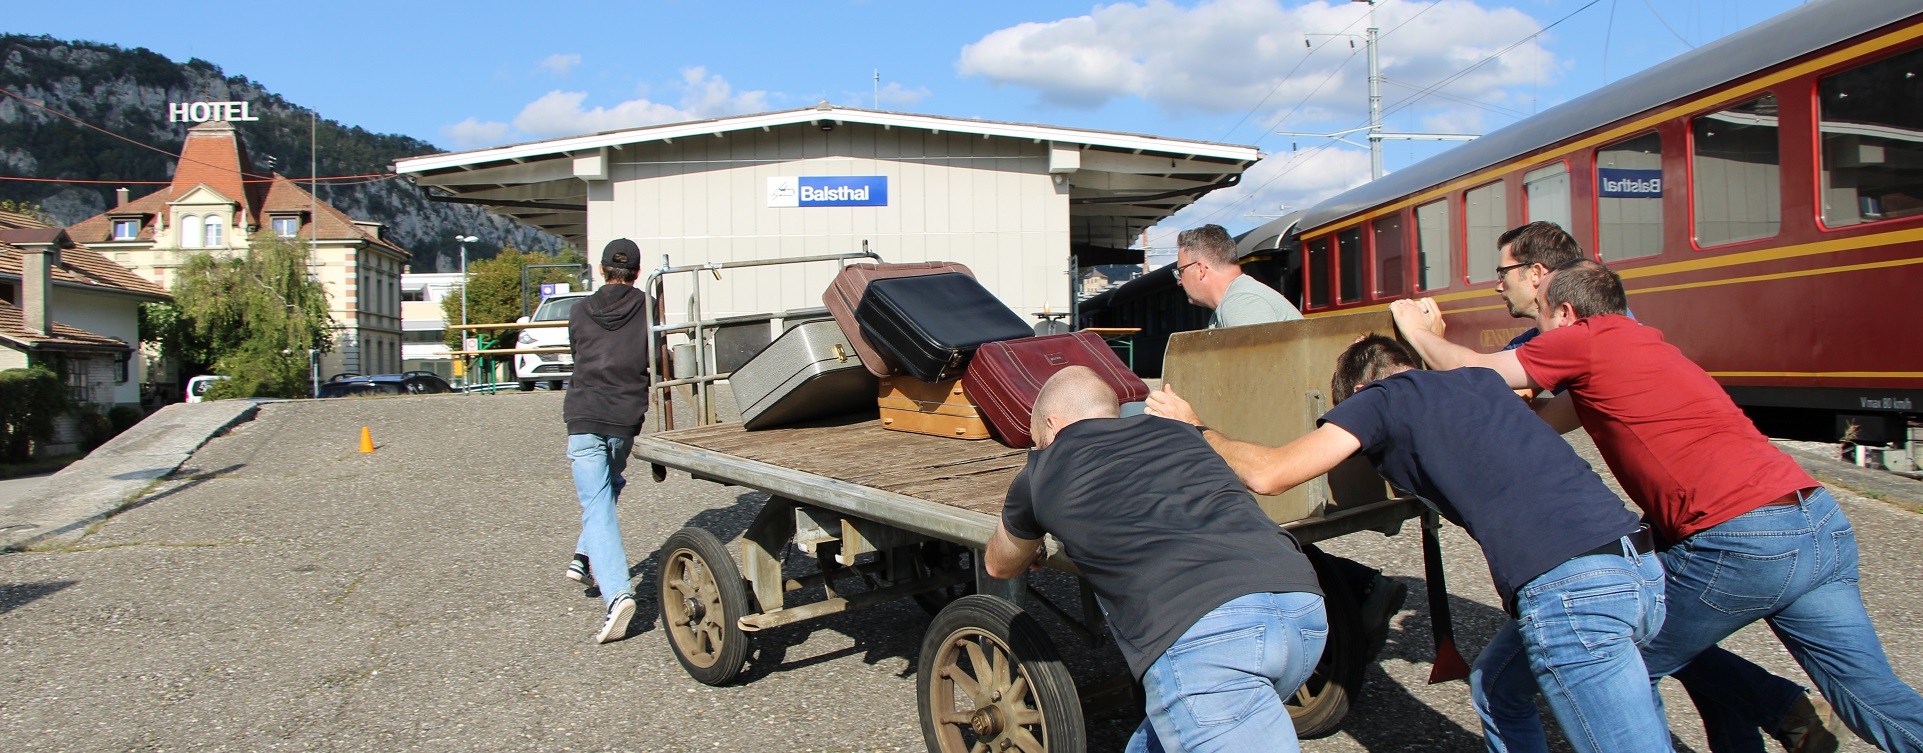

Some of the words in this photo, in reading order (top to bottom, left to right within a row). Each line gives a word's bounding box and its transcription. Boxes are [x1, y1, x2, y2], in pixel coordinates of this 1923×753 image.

[169, 101, 259, 122] HOTEL
[800, 185, 869, 201] Balsthal
[1867, 400, 1881, 409] max
